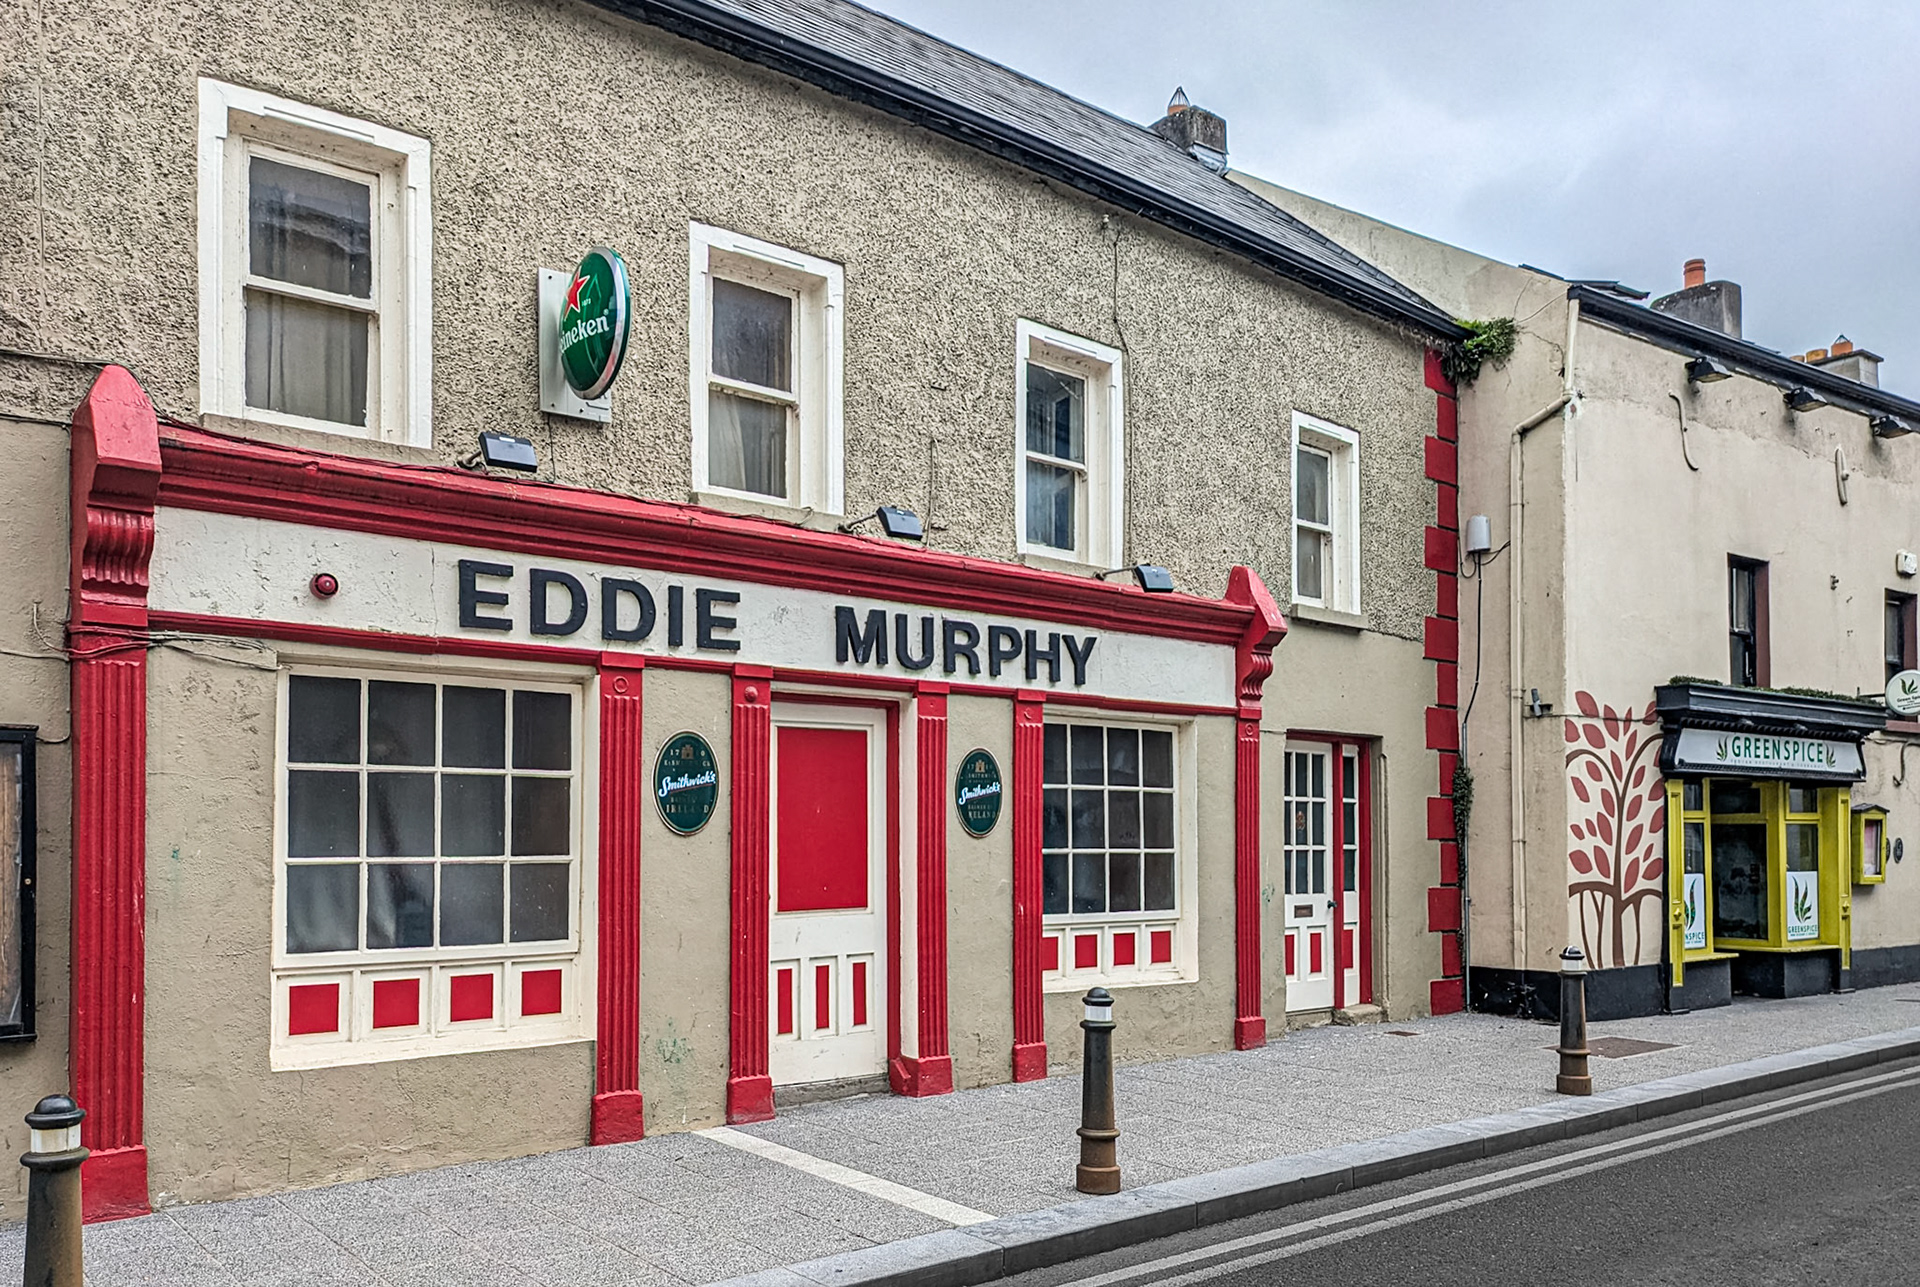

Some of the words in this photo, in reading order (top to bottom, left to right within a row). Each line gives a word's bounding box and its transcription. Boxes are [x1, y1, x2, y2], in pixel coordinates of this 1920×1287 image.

[560, 315, 609, 353] eineken
[458, 559, 741, 651] EDDIE
[834, 605, 1097, 686] MURPHY
[1732, 736, 1823, 763] GREENSPICE
[658, 770, 716, 797] Smithwick's
[959, 782, 1001, 805] Smithwick's
[1685, 931, 1704, 940] NSPICE
